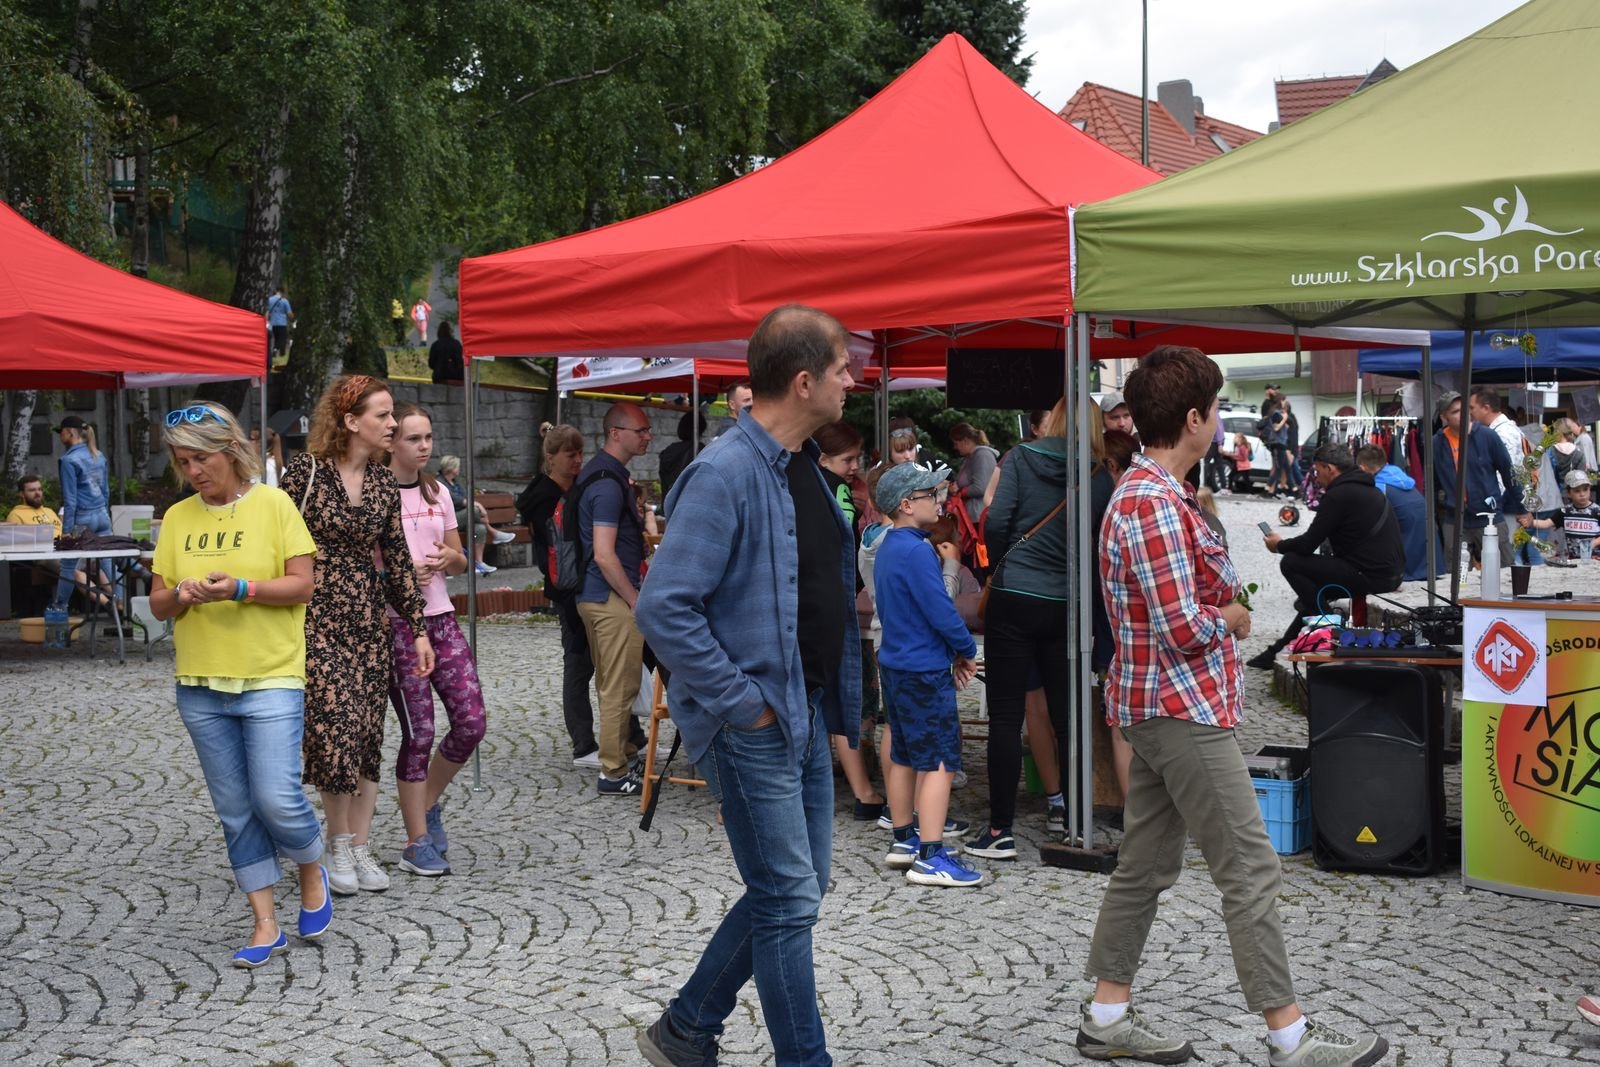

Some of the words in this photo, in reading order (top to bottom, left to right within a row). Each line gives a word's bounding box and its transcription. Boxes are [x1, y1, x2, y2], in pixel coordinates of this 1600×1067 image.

[1290, 270, 1351, 286] www.
[1357, 247, 1519, 288] Szklarska
[184, 530, 244, 552] LOVE
[1484, 633, 1525, 677] ART
[1546, 637, 1600, 657] OŚROD
[1514, 824, 1574, 871] LOKALNEJ
